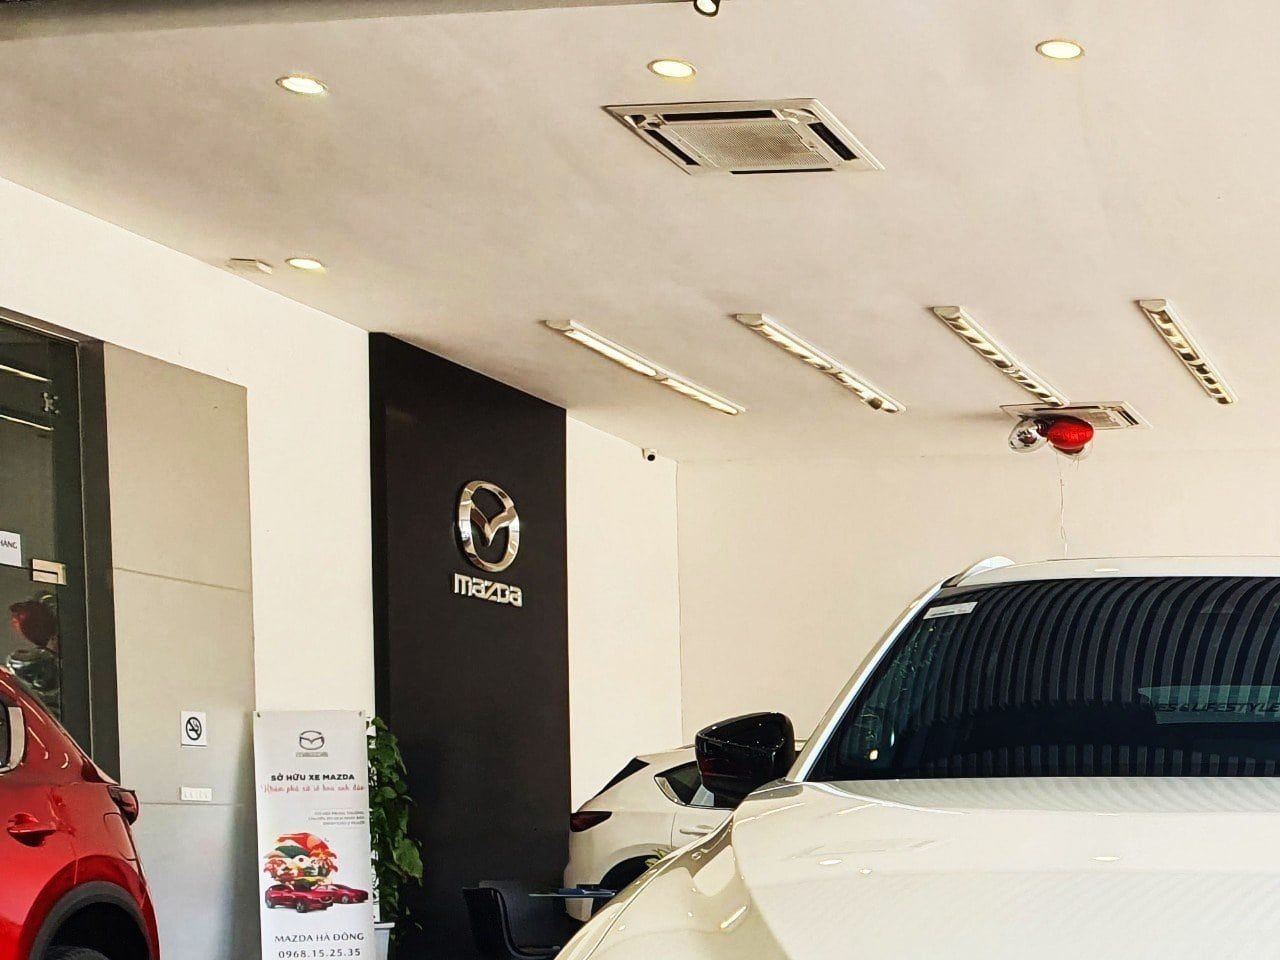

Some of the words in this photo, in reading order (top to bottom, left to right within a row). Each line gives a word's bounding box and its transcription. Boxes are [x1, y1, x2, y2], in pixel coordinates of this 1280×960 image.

[322, 773, 355, 781] MAZDA
[274, 934, 313, 943] MAZDA
[316, 932, 330, 941] HÀ
[333, 931, 365, 941] ĐÔNG
[278, 948, 361, 959] 0968.15.25.35
